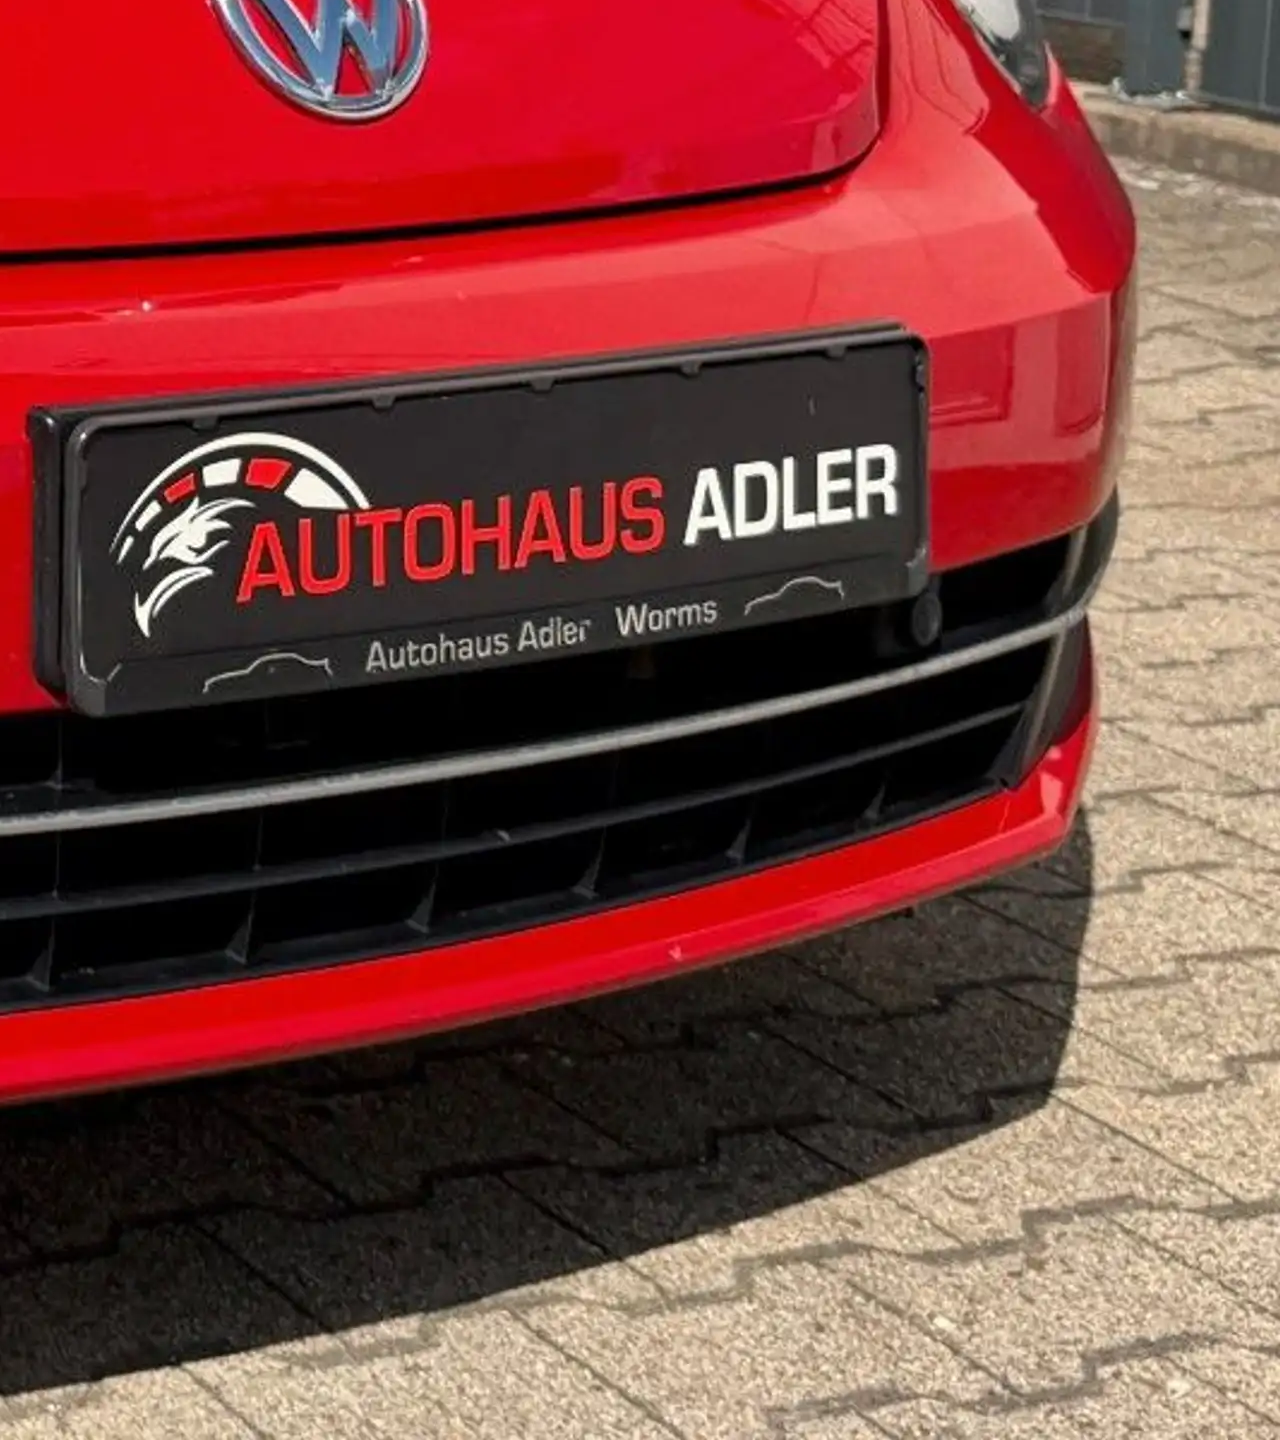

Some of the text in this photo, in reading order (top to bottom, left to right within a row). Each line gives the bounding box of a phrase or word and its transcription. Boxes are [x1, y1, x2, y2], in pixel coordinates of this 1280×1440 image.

[236, 442, 900, 605] AUTOHAUS ADLER
[364, 600, 719, 674] Autohaus Adler Worms
